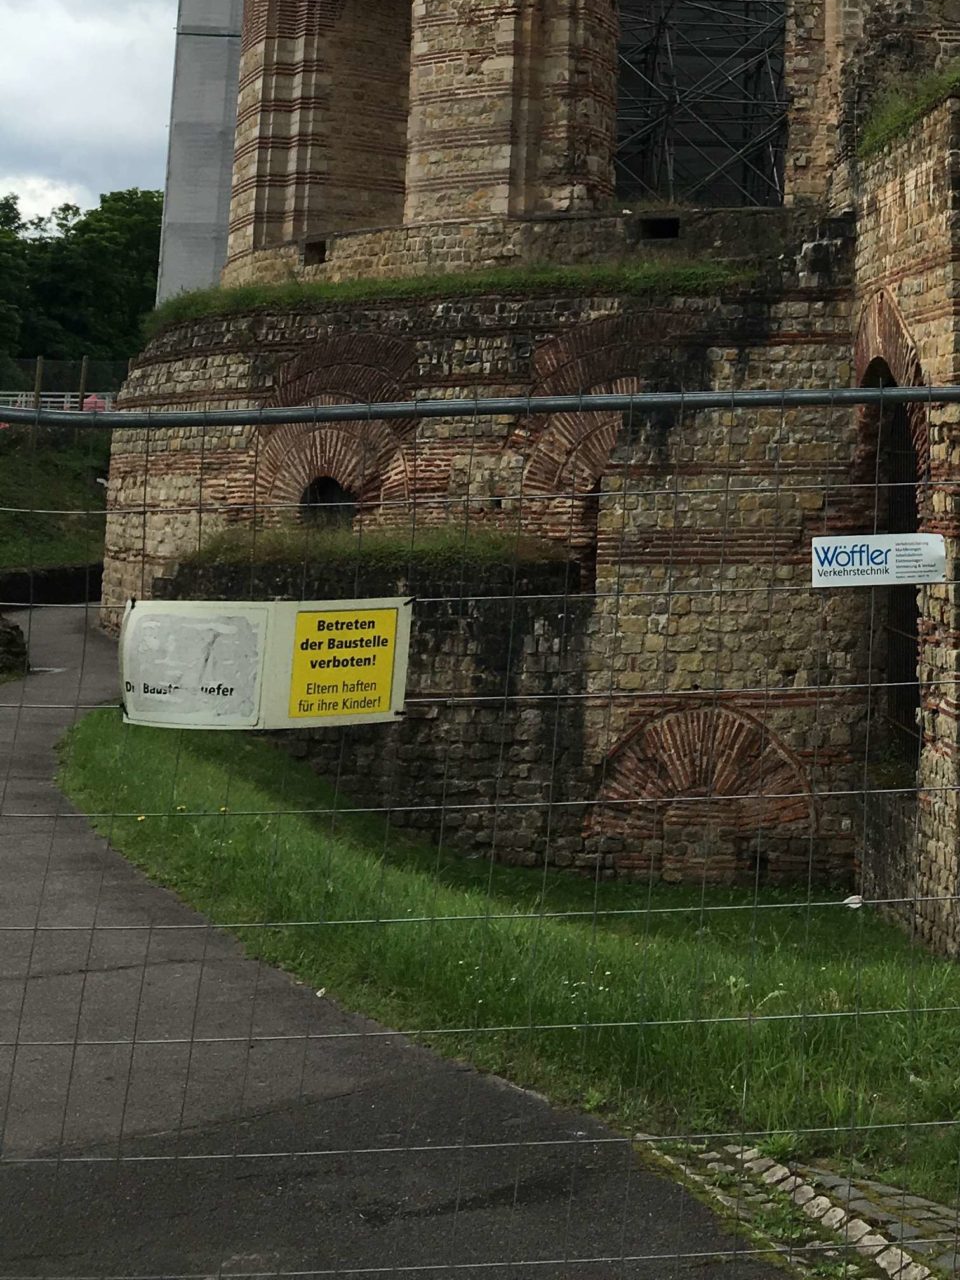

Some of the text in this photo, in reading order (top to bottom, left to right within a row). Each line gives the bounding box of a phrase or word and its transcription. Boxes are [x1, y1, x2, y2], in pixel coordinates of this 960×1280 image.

[814, 544, 892, 567] Wöffler
[817, 566, 890, 578] Verkehrstechnik
[317, 619, 376, 632] Betreten
[300, 635, 389, 651] der Baustelle
[310, 654, 376, 669] verboten!
[306, 679, 377, 695] Eltern haften
[298, 696, 381, 712] für ihre Kinder!
